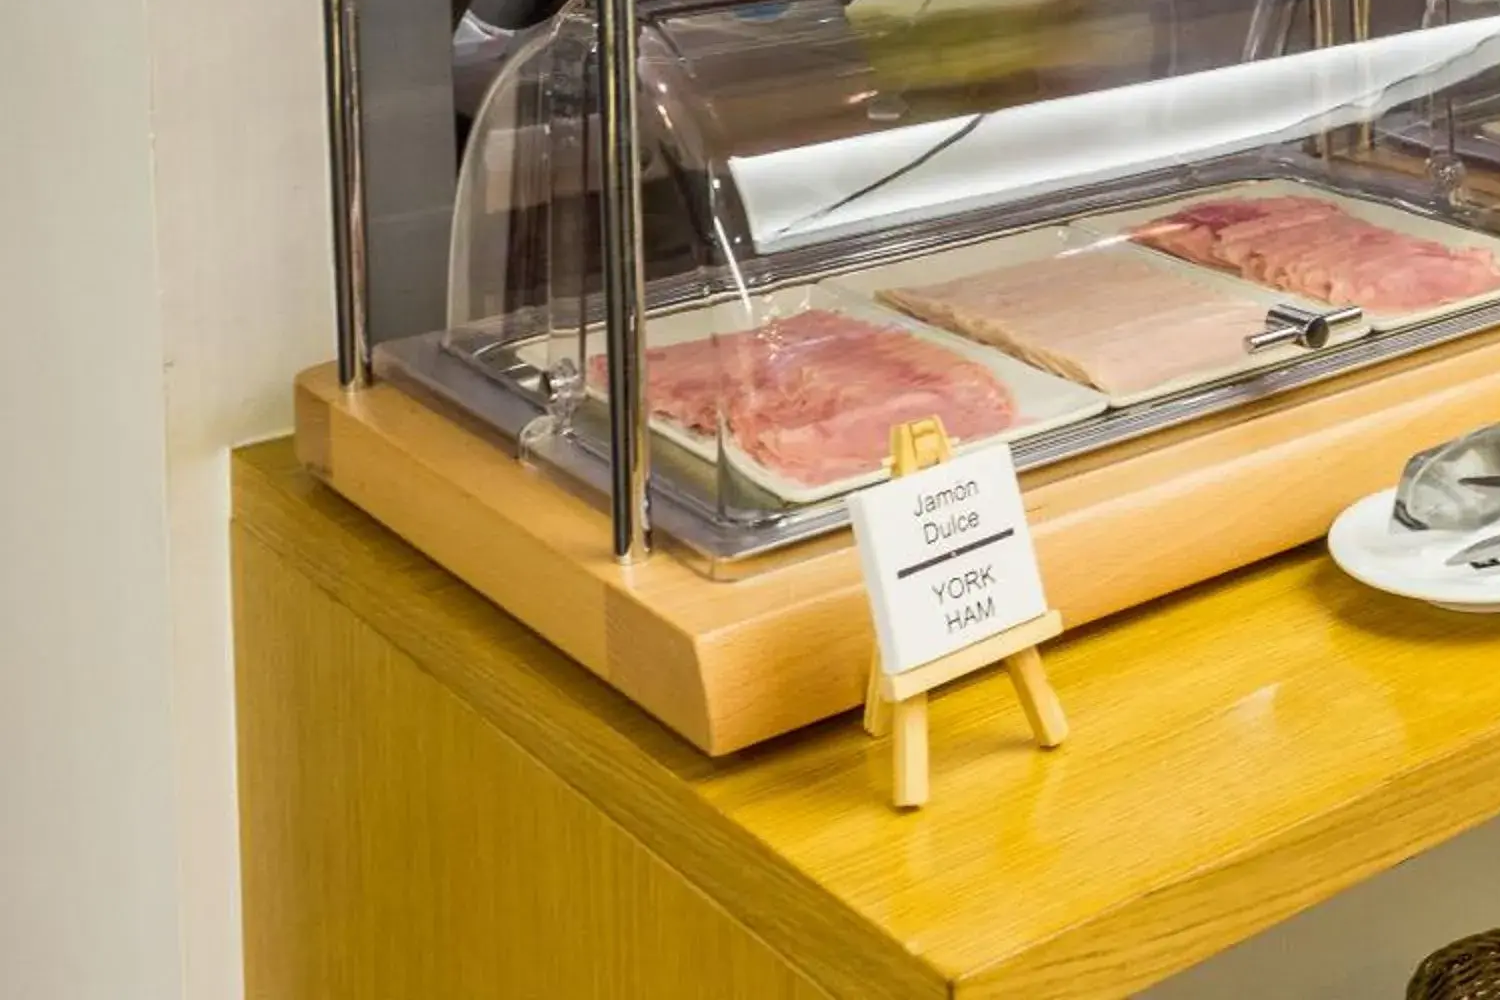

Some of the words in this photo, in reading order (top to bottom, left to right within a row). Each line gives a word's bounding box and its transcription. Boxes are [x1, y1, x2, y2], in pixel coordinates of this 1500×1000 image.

[923, 511, 979, 545] Dulce
[931, 564, 996, 604] YORK
[944, 596, 996, 633] HAM
